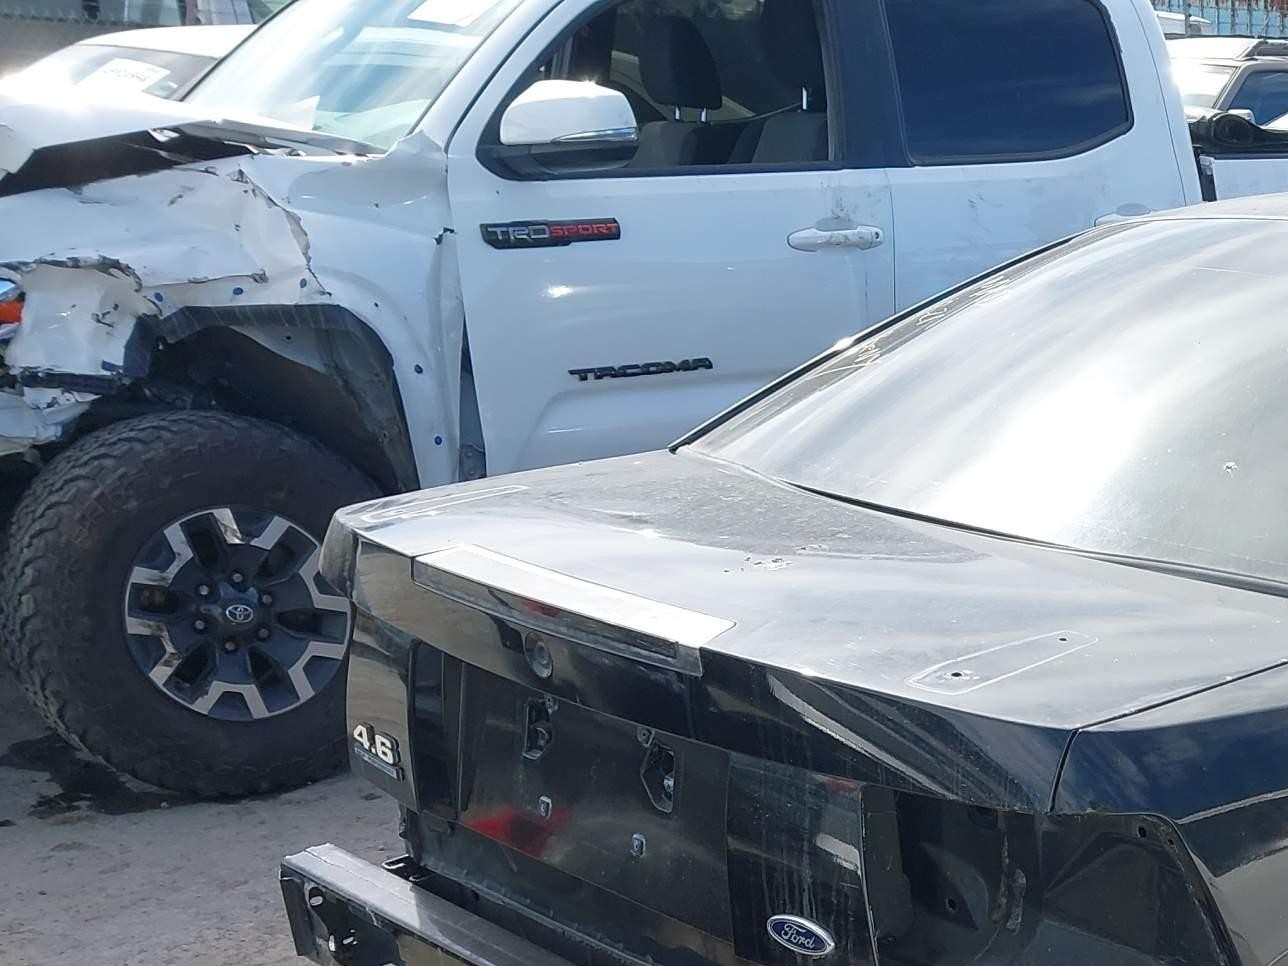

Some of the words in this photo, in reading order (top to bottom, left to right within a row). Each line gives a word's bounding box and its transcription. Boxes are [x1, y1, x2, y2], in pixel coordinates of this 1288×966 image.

[487, 224, 550, 242] TRD
[550, 223, 618, 237] SPORT
[567, 357, 713, 381] TACOMA
[353, 724, 395, 765] 4.6
[781, 923, 816, 949] Ford
